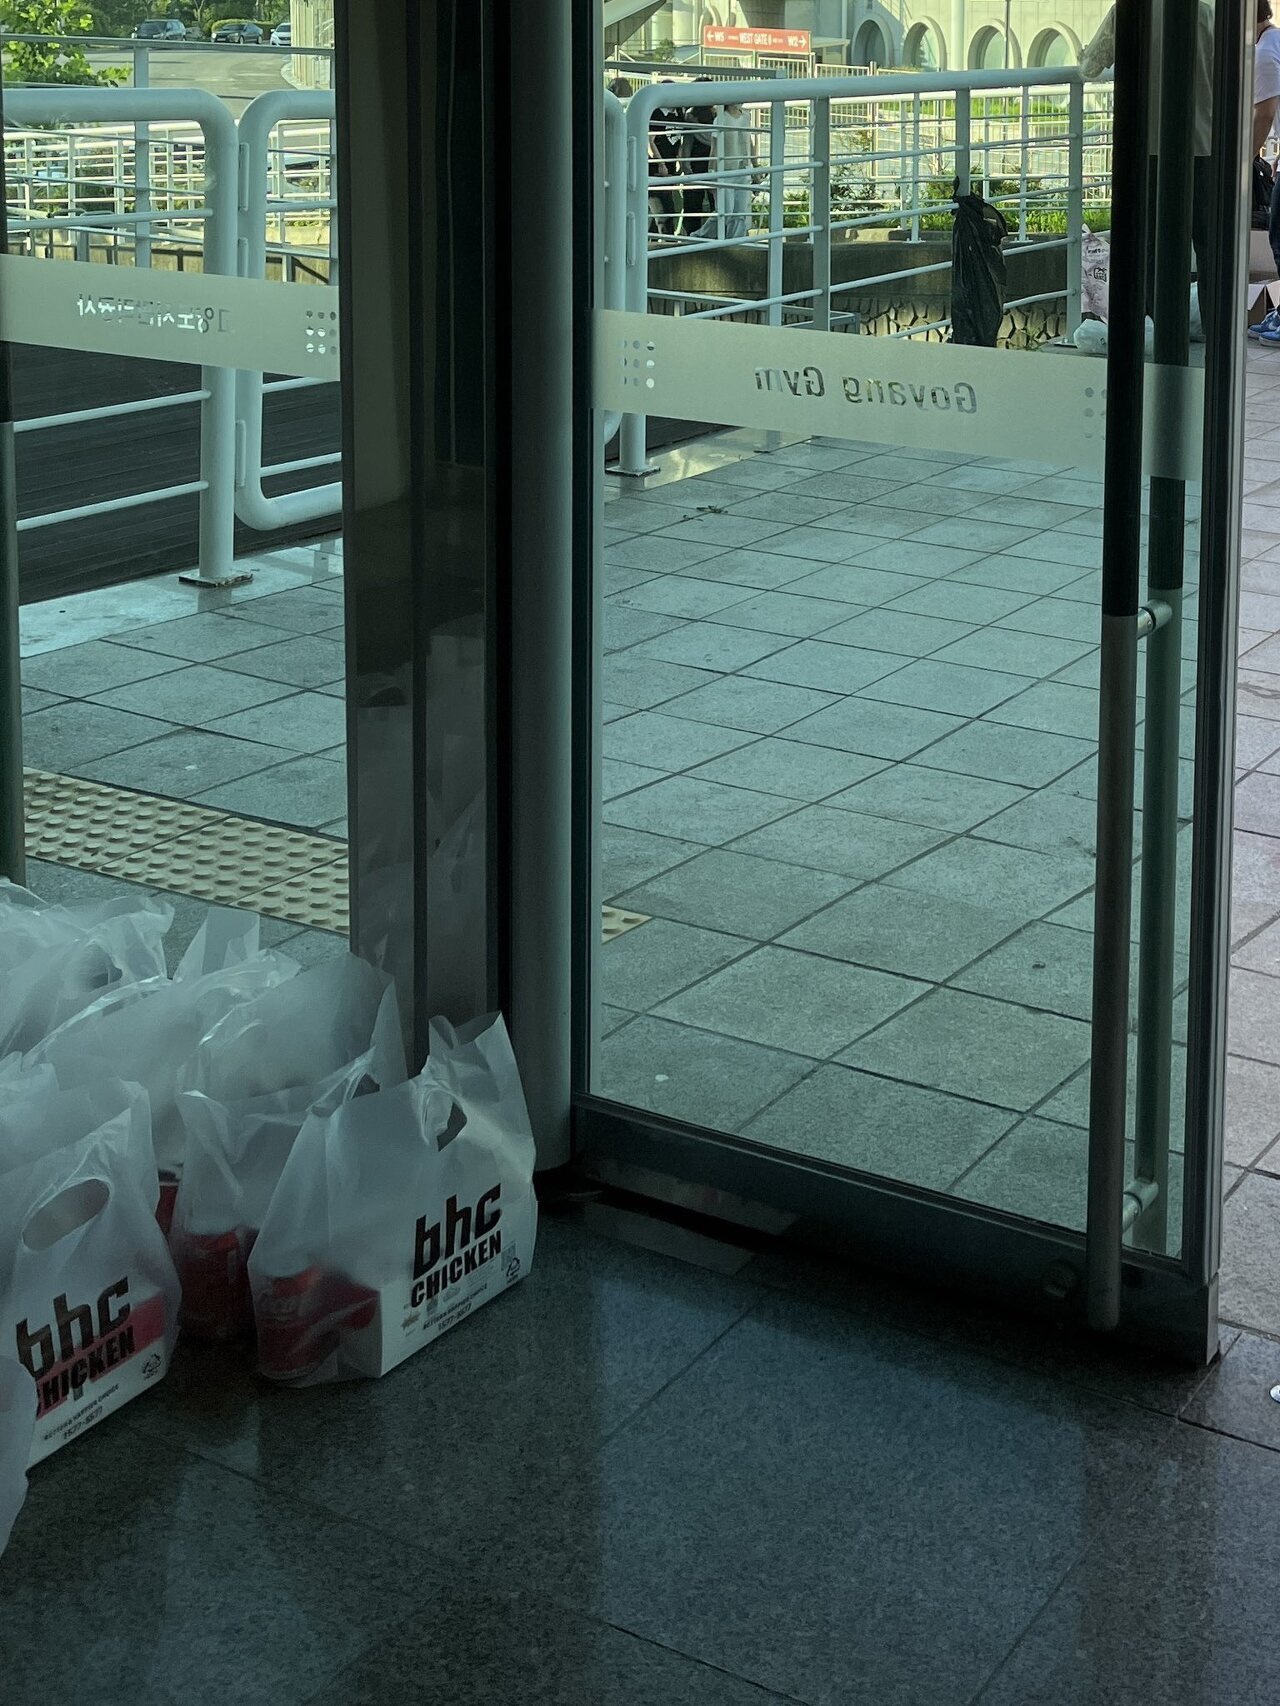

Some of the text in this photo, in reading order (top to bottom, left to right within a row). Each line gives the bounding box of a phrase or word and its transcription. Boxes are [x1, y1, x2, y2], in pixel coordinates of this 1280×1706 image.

[739, 33, 754, 44] WEST
[754, 33, 768, 45] GATE
[787, 35, 799, 47] W2
[410, 1230, 503, 1308] CHICKEN
[413, 1183, 503, 1281] bhc
[16, 1276, 131, 1381] bhc
[36, 1325, 136, 1417] HICKEN
